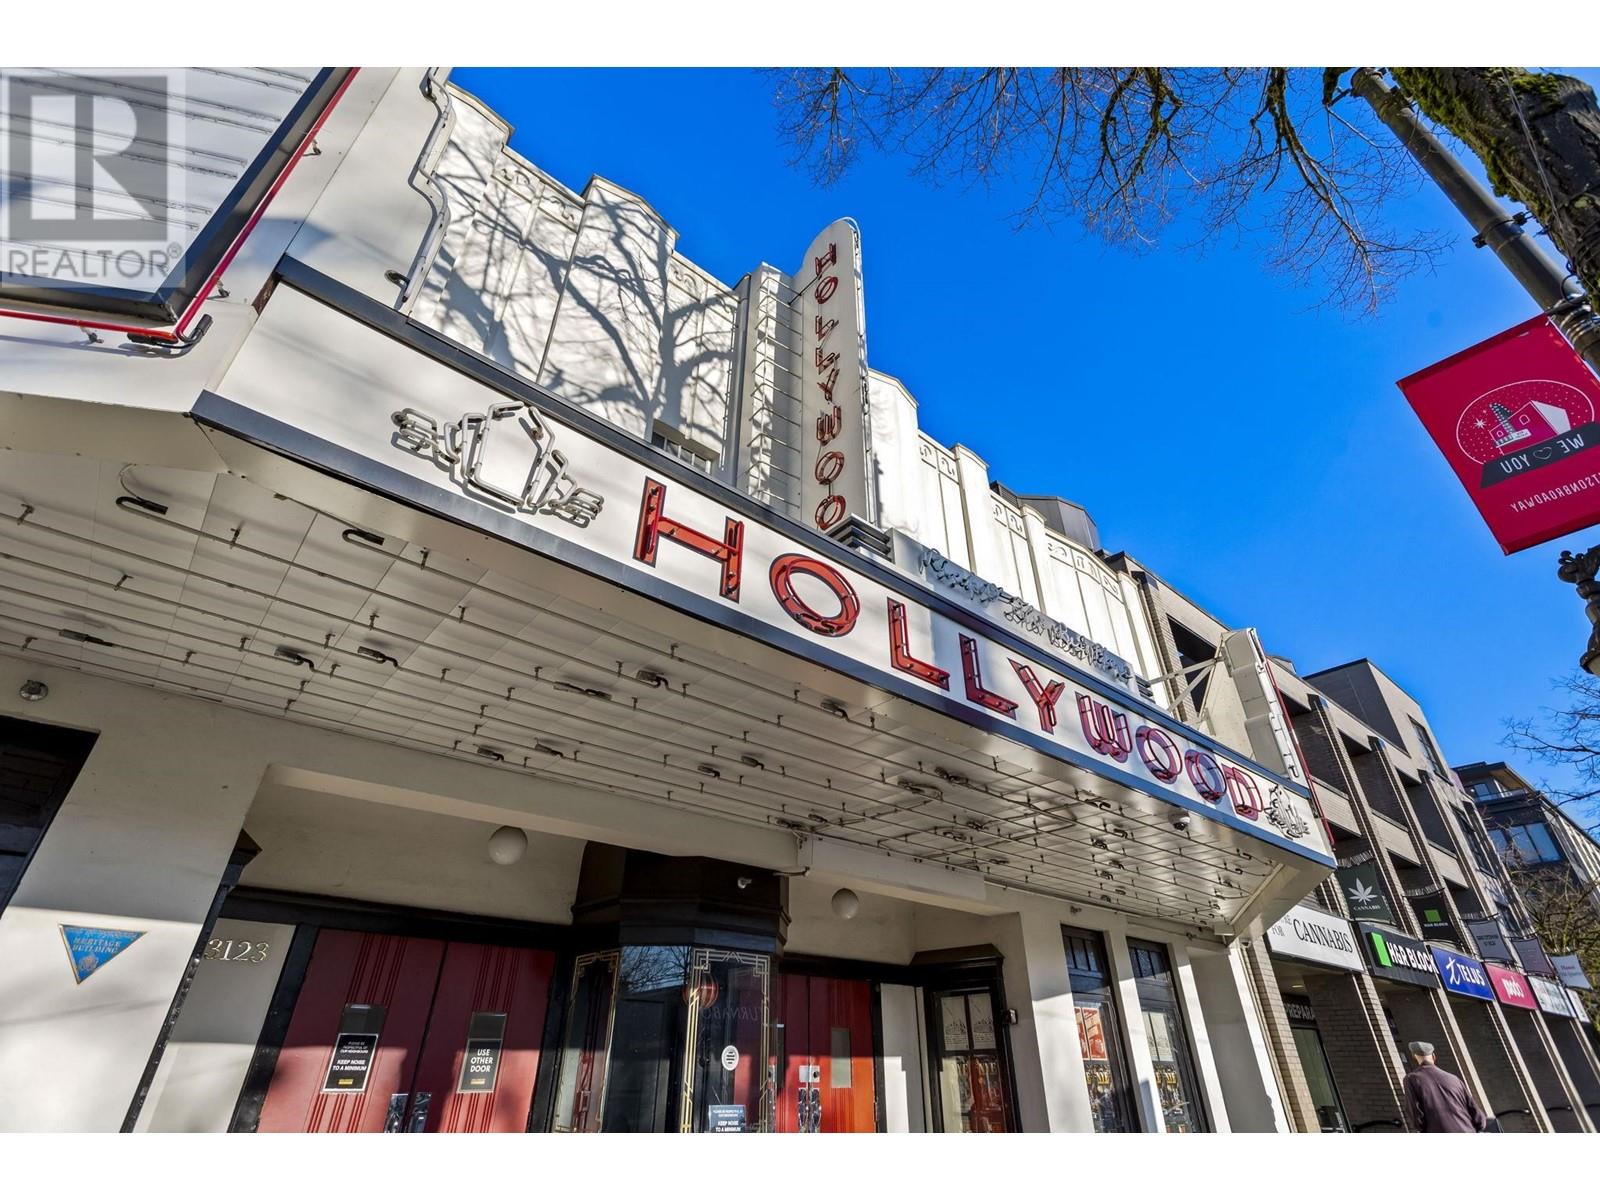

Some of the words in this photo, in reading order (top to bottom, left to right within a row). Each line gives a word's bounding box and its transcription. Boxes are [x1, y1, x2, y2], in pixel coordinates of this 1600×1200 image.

[814, 242, 846, 531] HOLLYWOO
[632, 477, 1262, 821] HOLLYWOOD
[203, 938, 271, 963] 3123
[1293, 919, 1353, 953] CANNABIS
[1386, 941, 1410, 967] H&R
[1405, 947, 1439, 975] BLOCK
[1456, 963, 1485, 987] TELUS
